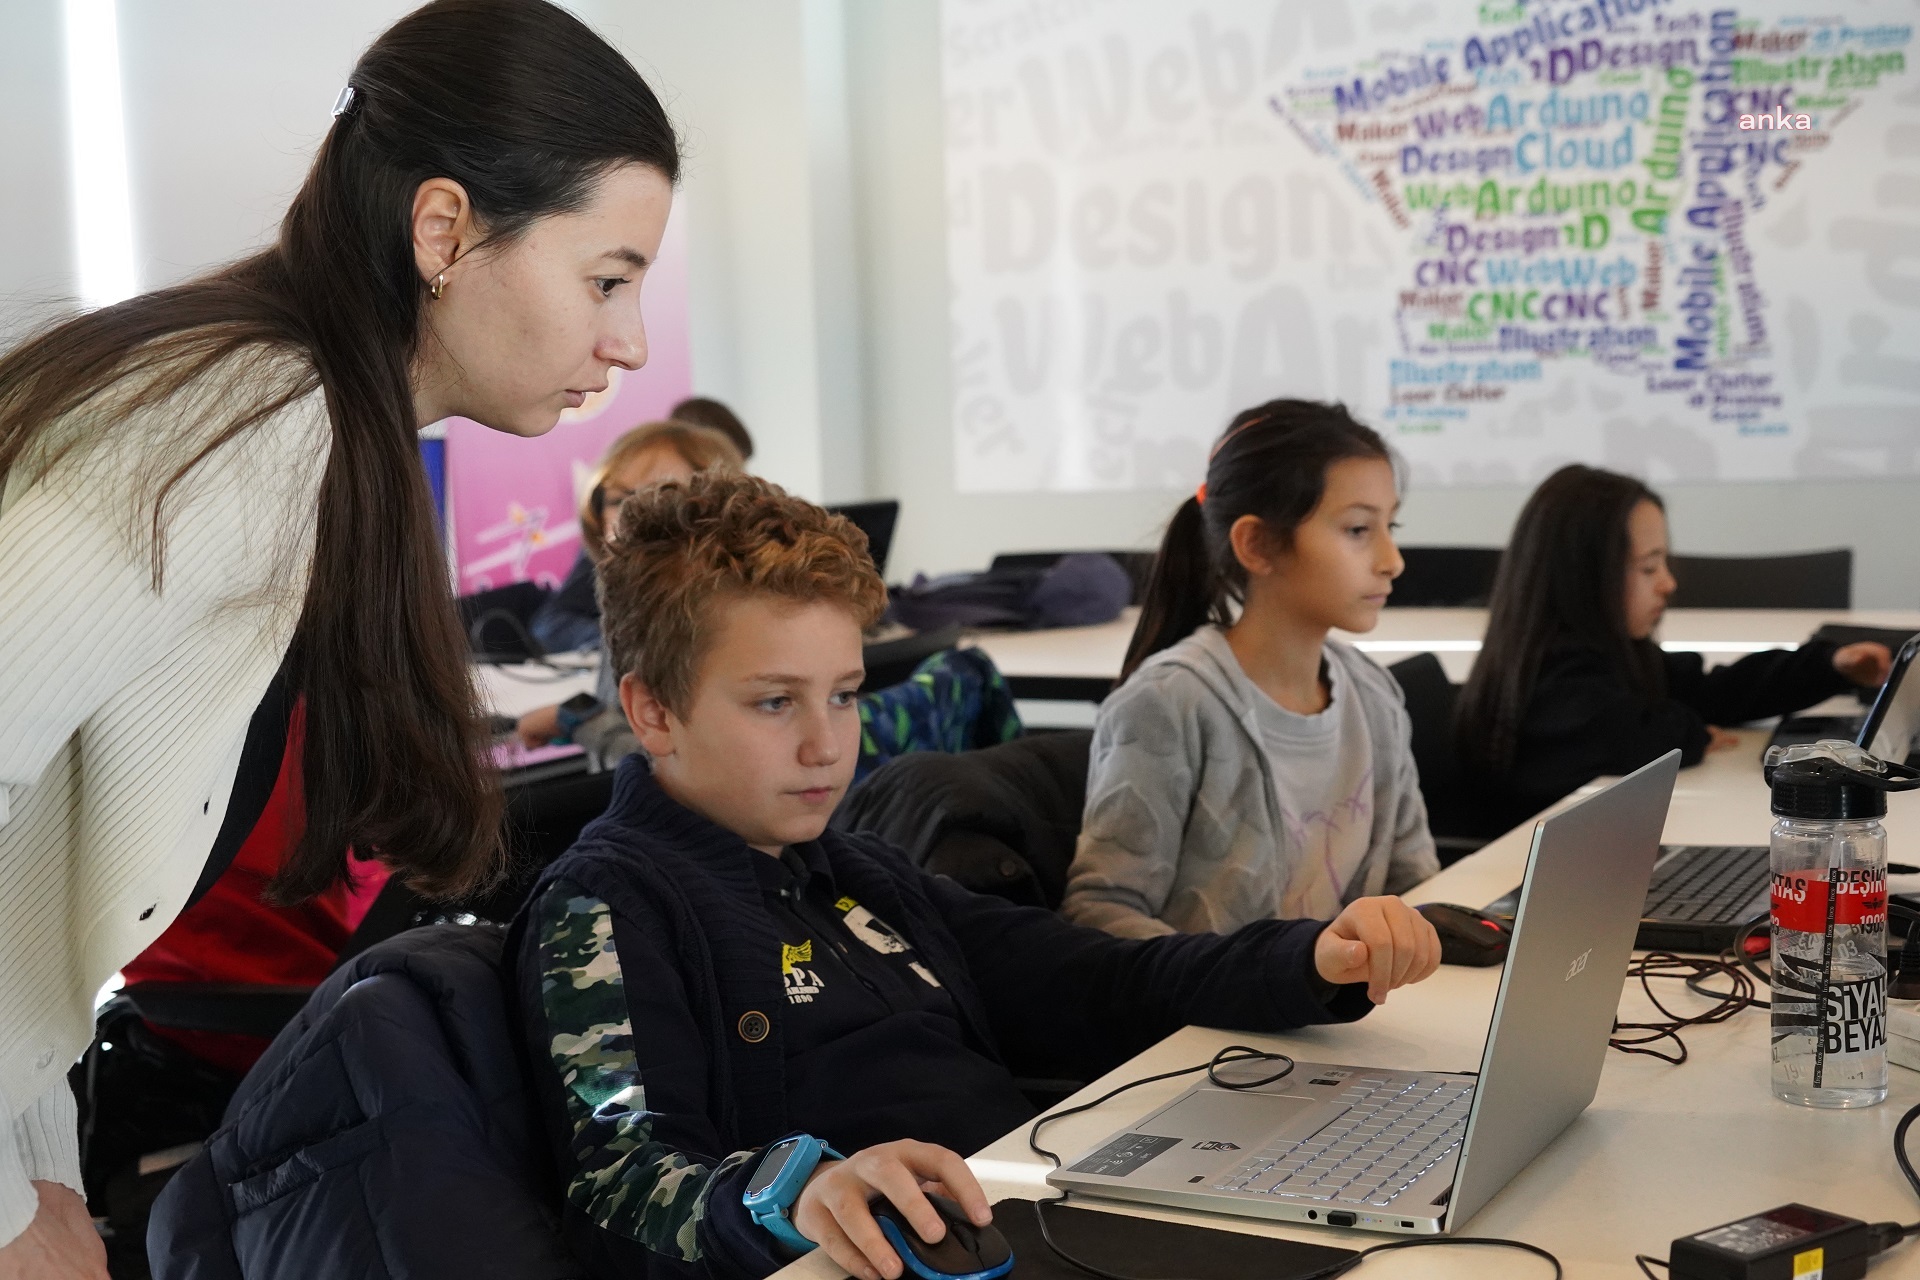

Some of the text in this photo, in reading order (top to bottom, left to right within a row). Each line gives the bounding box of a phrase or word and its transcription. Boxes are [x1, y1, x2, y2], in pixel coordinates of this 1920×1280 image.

[1333, 0, 1670, 115] Mobile Applicatio
[1414, 103, 1486, 139] Web
[1486, 87, 1650, 135] Arduino
[1402, 146, 1514, 175] Design
[1515, 124, 1634, 176] Cloud
[1630, 67, 1695, 234] Arduino
[1475, 176, 1638, 222] Arduino
[1673, 9, 1737, 371] Mobile Application
[1447, 222, 1560, 255] Design
[1414, 258, 1480, 288] CNC
[1557, 255, 1637, 288] Web
[1467, 289, 1541, 323] CNC
[1543, 290, 1612, 322] CNC
[783, 967, 825, 988] PA
